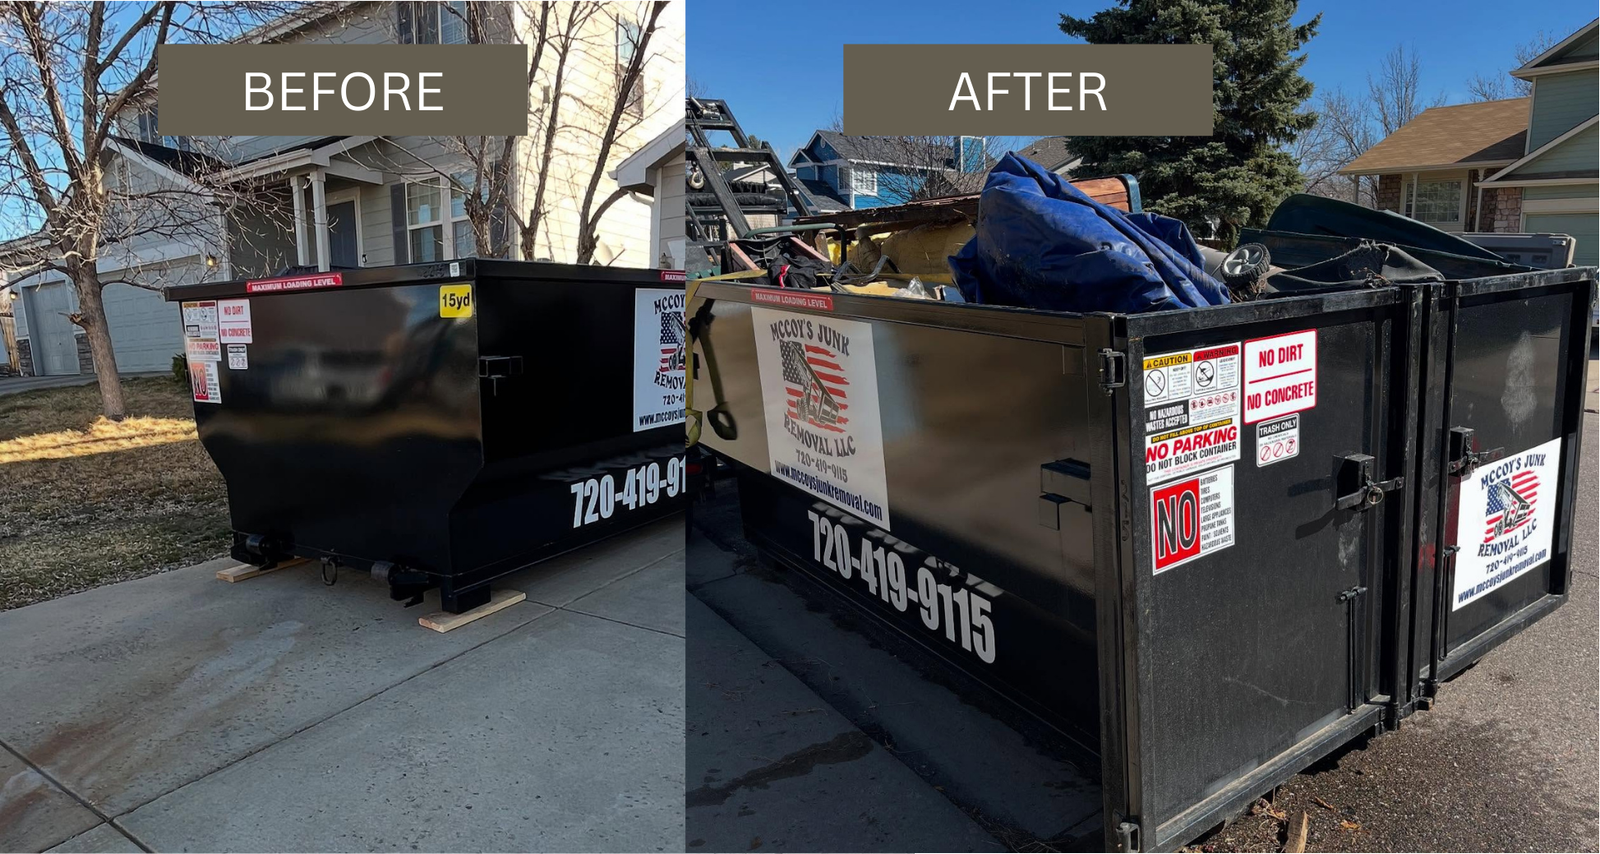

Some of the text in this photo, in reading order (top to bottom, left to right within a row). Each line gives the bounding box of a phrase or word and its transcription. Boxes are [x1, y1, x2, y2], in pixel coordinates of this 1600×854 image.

[252, 278, 336, 292] MAXIMUM LOADING LEVEL
[442, 292, 470, 310] 15yd
[756, 293, 828, 308] MAXIMUM LOADING LEVEL
[224, 306, 244, 315] NO DIRT
[221, 328, 228, 336] NO
[228, 328, 250, 336] CONCRETE
[770, 318, 850, 356] MCCOY'S JUNK
[196, 342, 218, 350] PARKING
[1204, 346, 1236, 358] WARNING
[1153, 355, 1188, 367] CAUTION
[1259, 344, 1304, 368] NO DIRT
[654, 370, 686, 390] REMOV
[1248, 381, 1314, 410] NO CONCRETE
[1150, 411, 1156, 420] NO
[1158, 405, 1184, 419] HAZARDOUS
[1146, 414, 1188, 432] WASTES ACCEPTED
[1208, 419, 1232, 428] CONTAINER
[1260, 419, 1296, 436] TRASH ONLY
[784, 412, 856, 458] REMOVAL LLC
[1146, 442, 1169, 463] NO
[1172, 426, 1238, 456] PARKING
[796, 448, 848, 483] 720-419-9115
[1146, 462, 1156, 474] DO
[1158, 458, 1173, 470] NOT
[1174, 452, 1198, 466] BLOCK
[1200, 441, 1236, 458] CONTAINER
[1200, 474, 1218, 486] BATTERIES
[1481, 454, 1546, 490] MCCOY'S JUNK
[570, 455, 686, 528] 720-419-91
[774, 460, 882, 521] www.mccoysjunkremoval.com
[1201, 486, 1210, 495] TIRES
[1201, 492, 1220, 504] COMPUTERS
[1201, 501, 1221, 514] TELEVISIONS
[1201, 507, 1231, 524] LARGE APPLIANCES
[1157, 490, 1198, 560] NO
[1202, 534, 1231, 550] HAZARDOUS WASTE
[1477, 518, 1538, 558] REMOVAL LLC
[1486, 545, 1528, 574] 720-419-9115
[1458, 548, 1547, 604] www.mccoysjunkremoval.com
[808, 510, 996, 664] 720-419-9115
